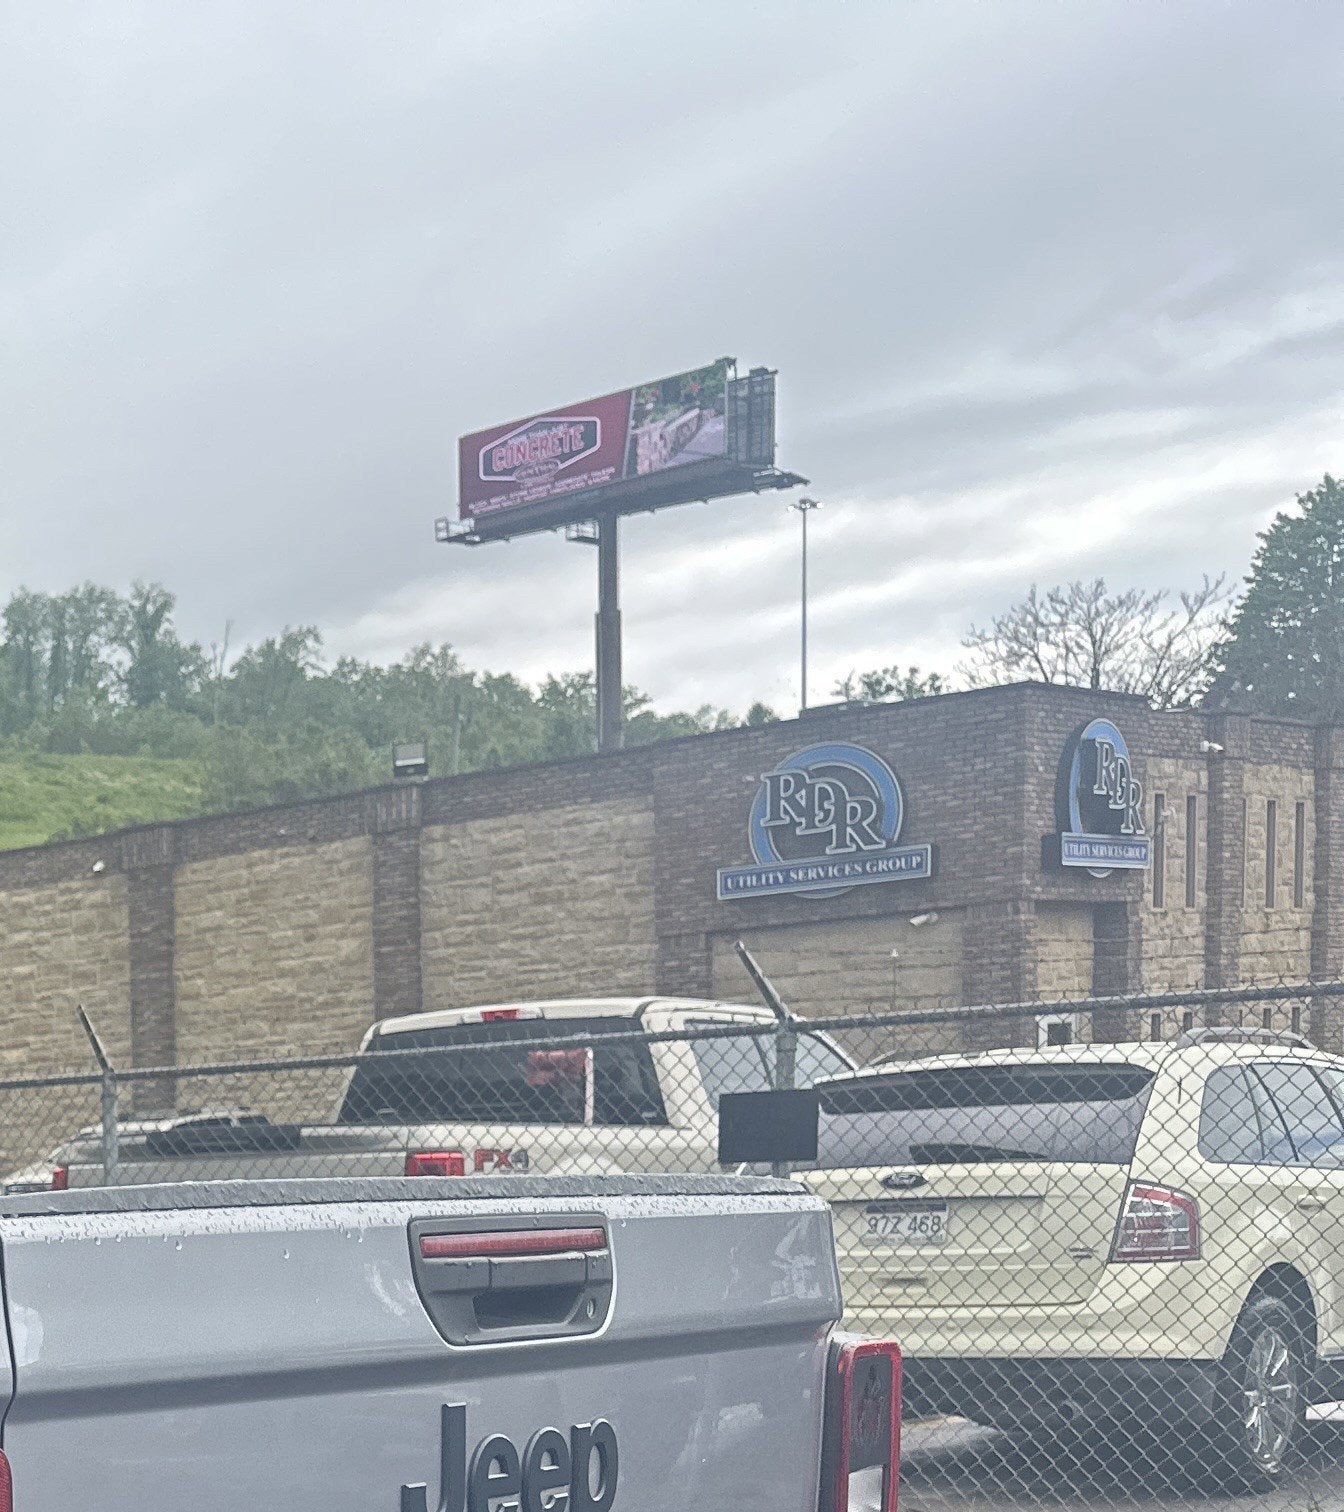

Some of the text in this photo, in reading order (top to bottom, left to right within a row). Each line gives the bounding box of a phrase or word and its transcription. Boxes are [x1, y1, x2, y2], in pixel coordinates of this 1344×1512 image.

[491, 423, 586, 473] CONCRETE
[1092, 735, 1147, 835] RDR
[759, 767, 887, 856] RDR
[726, 854, 923, 890] UTILITY SERVICES GROUP
[474, 1147, 530, 1172] FX4
[908, 1214, 942, 1235] 468
